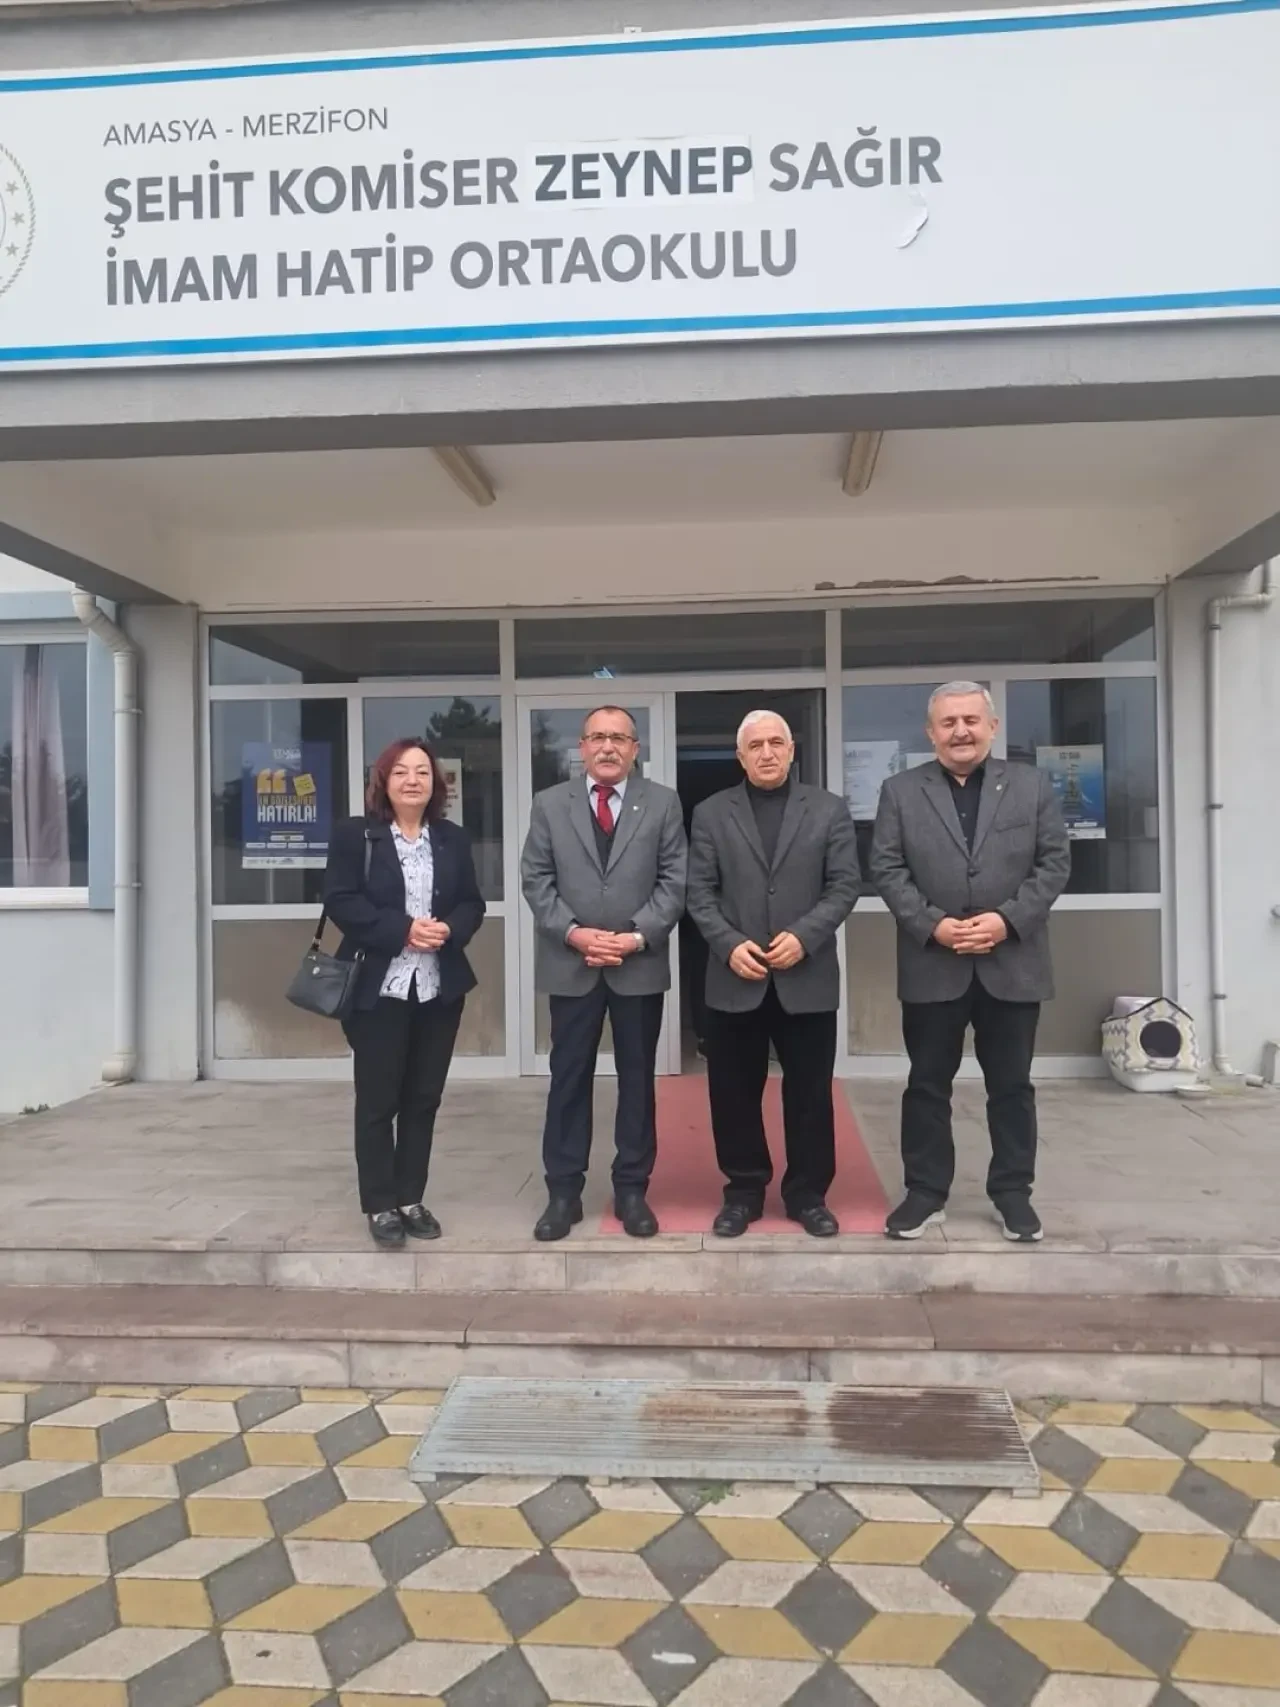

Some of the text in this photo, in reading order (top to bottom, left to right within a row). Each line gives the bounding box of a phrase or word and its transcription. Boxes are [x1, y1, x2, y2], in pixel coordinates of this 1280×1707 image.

[102, 117, 217, 148] AMASYA
[242, 106, 388, 138] MERZİFON
[103, 125, 943, 240] ŞEHİT KOMİSER ZEYNEP SAĞIR
[106, 227, 797, 306] İMAM HATİP ORTAOKULU
